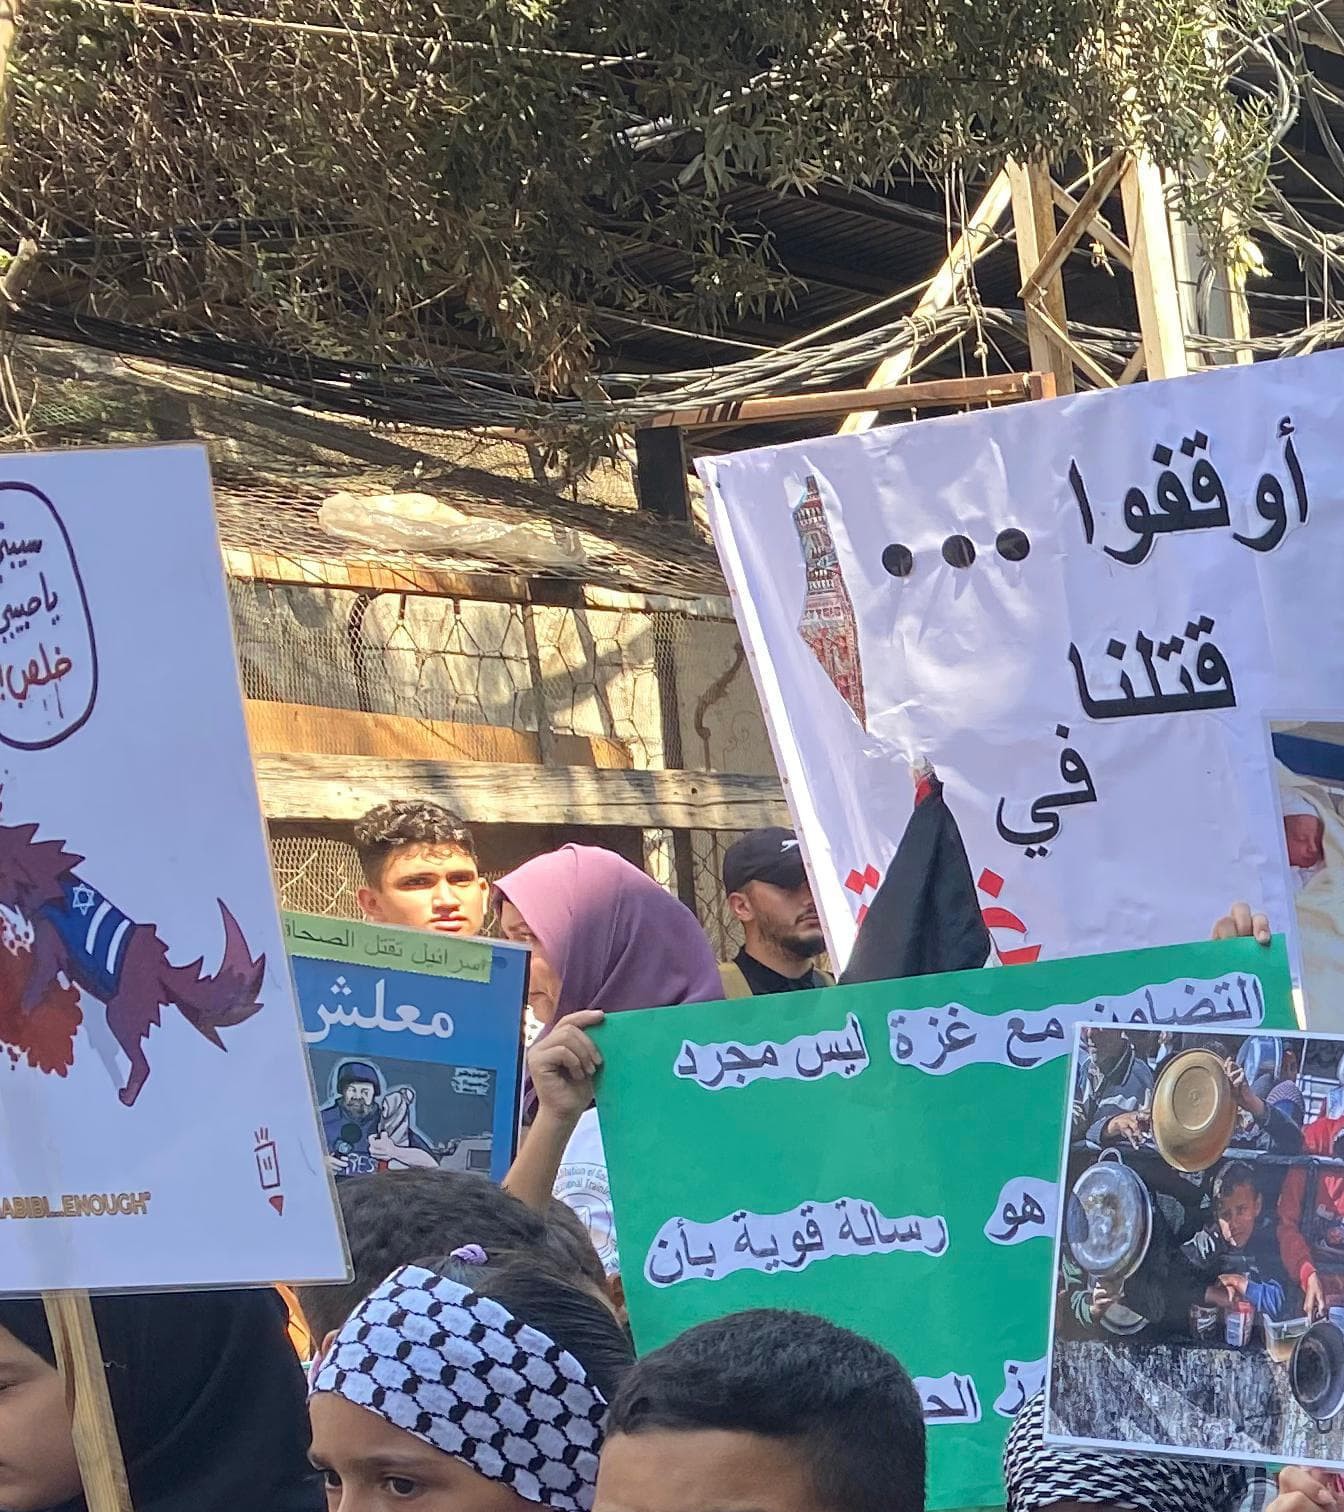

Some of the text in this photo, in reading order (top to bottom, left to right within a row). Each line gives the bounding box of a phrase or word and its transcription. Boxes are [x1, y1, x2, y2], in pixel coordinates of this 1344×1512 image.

[1069, 416, 1308, 565] أوقفوا
[1067, 614, 1237, 719] قتلنا
[997, 723, 1098, 859] في
[303, 976, 455, 1043] معلش
[891, 1006, 978, 1069] غزة
[1006, 1015, 1064, 1068] مع
[676, 1041, 778, 1087] مجرد
[795, 1014, 870, 1078] ليس
[732, 1204, 825, 1271] قوية
[834, 1199, 946, 1252] رسالة
[988, 1191, 1046, 1241] هو
[649, 1217, 717, 1285] بأن
